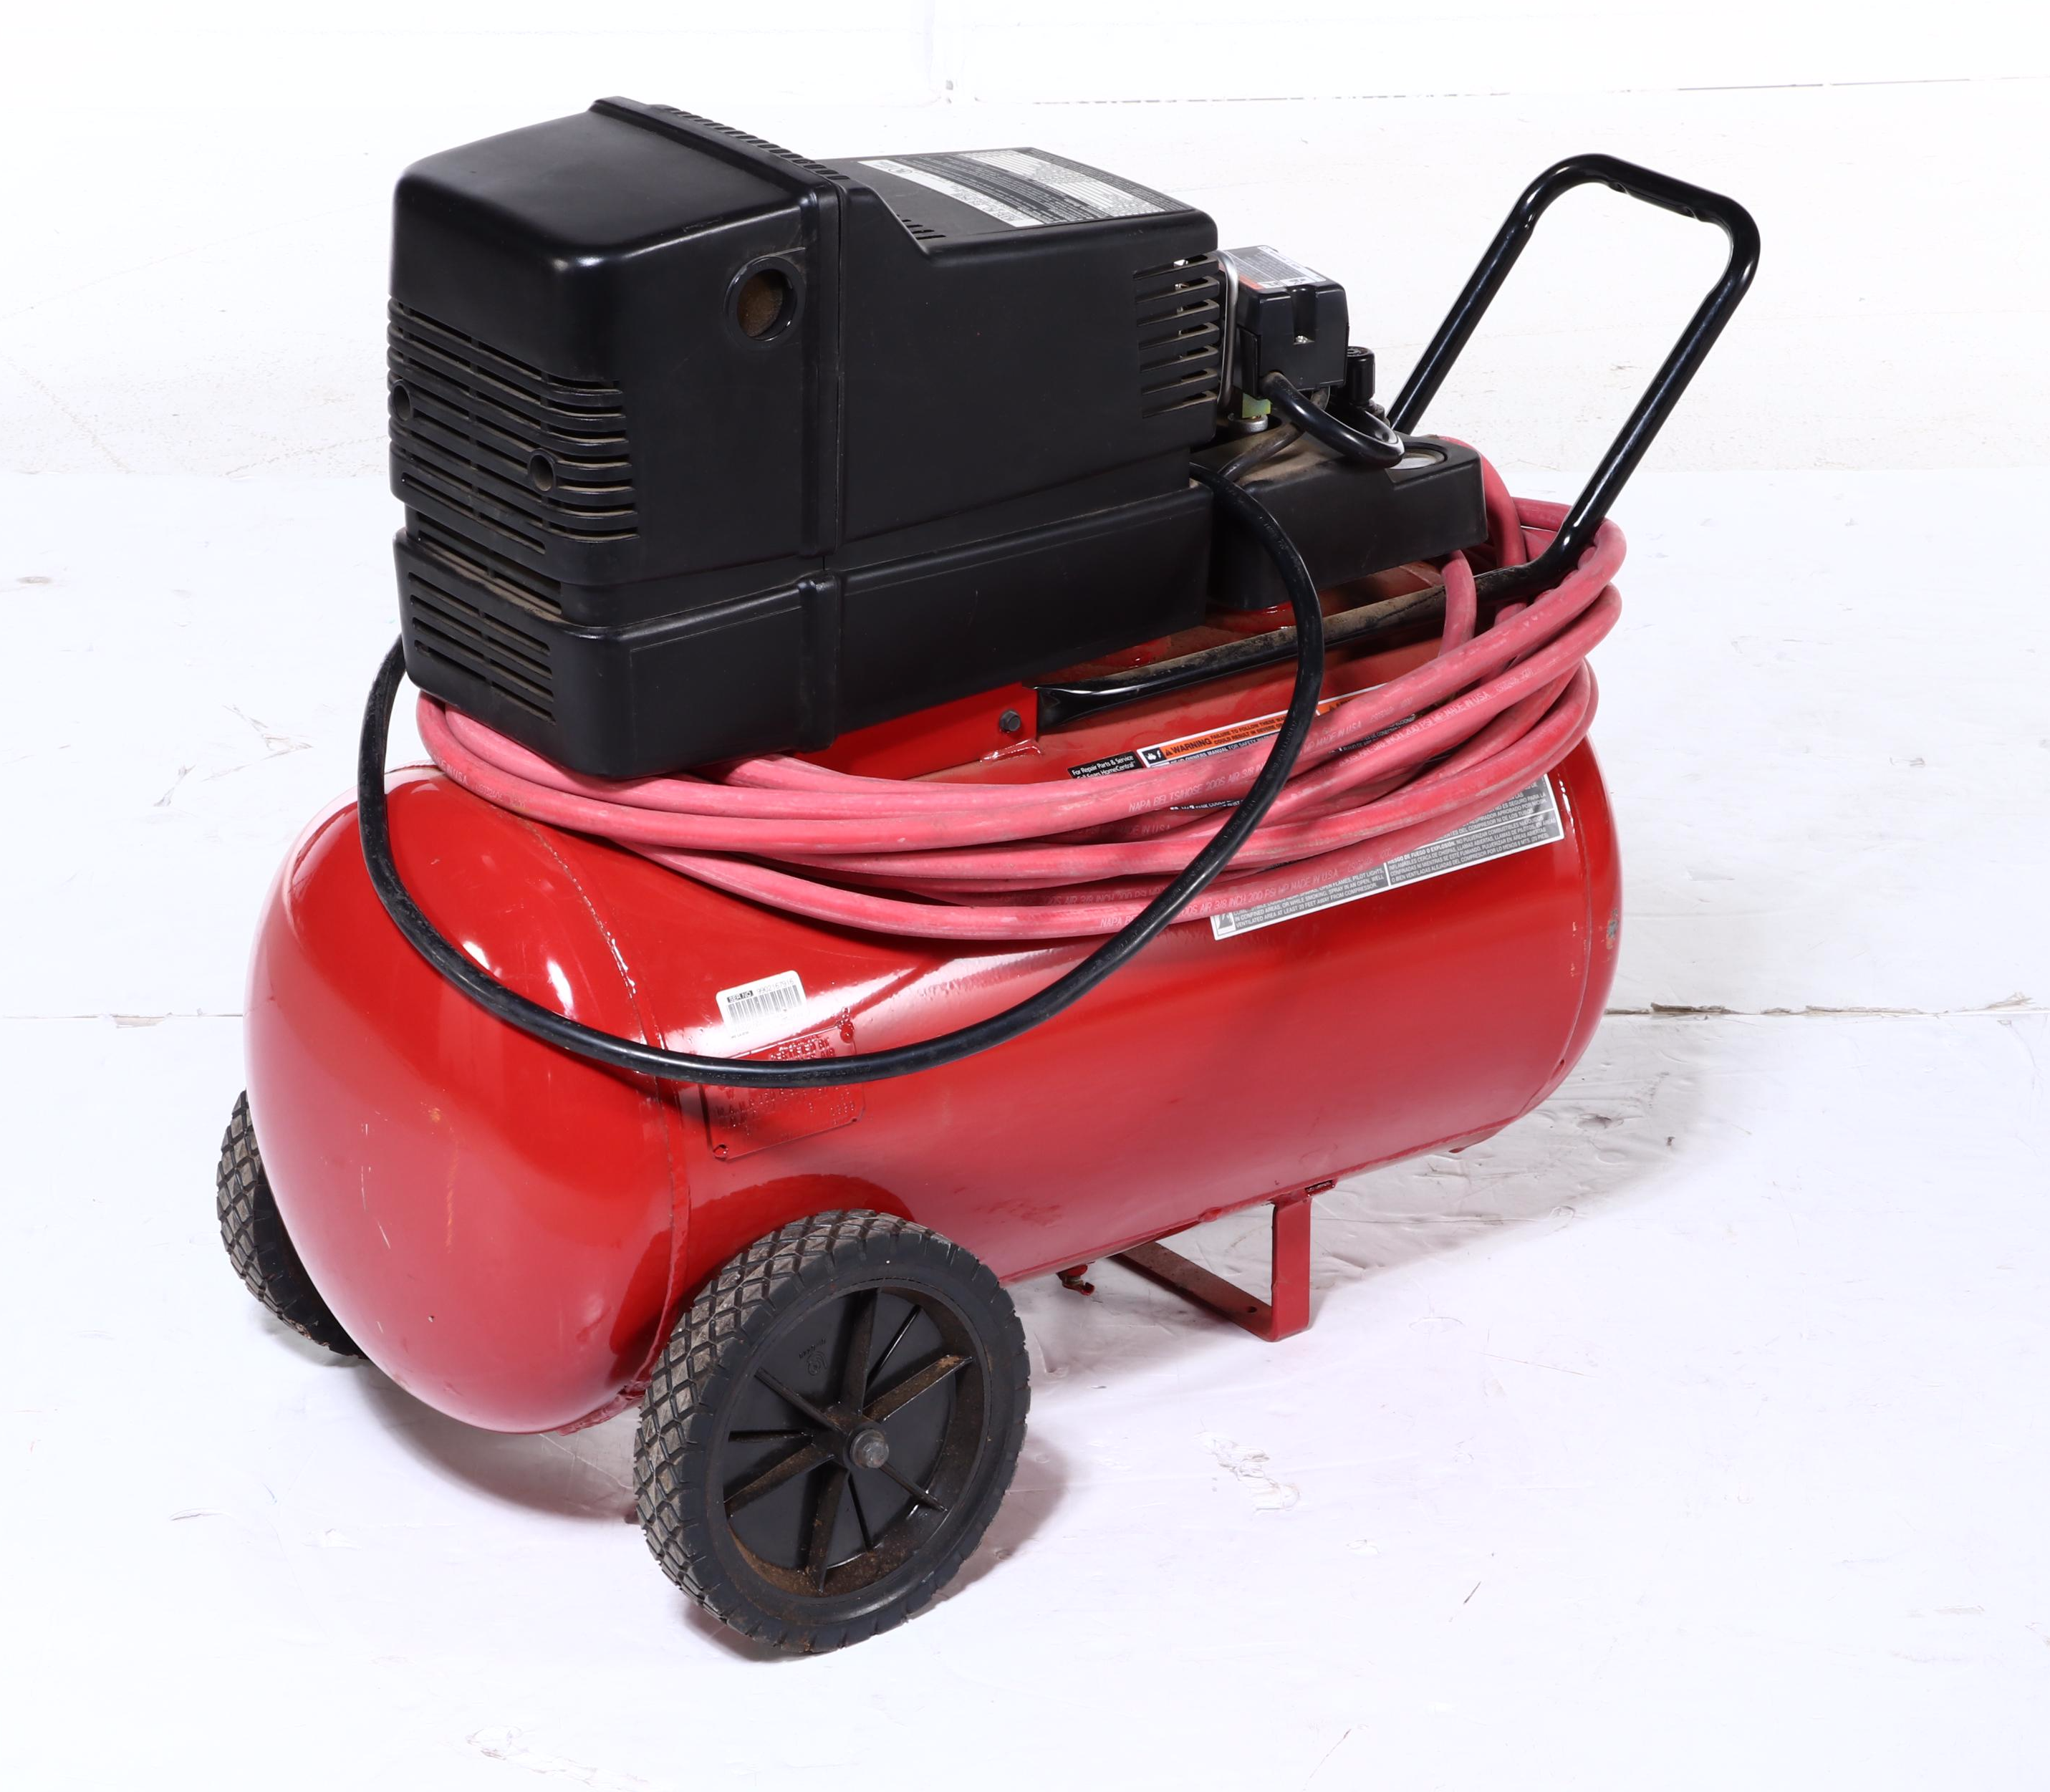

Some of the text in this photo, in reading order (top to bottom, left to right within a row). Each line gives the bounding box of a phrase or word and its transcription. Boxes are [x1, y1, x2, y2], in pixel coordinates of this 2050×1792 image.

[1472, 691, 1491, 707] USA
[1238, 722, 1259, 732] FOLLOW
[1170, 735, 1212, 754] WARNING
[1071, 768, 1081, 776] For
[1079, 763, 1098, 775] Repair
[1096, 760, 1111, 769] Parts
[1115, 753, 1134, 765] Service
[1129, 799, 1151, 813] NAPA
[1228, 772, 1240, 784] AIR
[1508, 796, 1527, 807] SEGURO
[1526, 793, 1539, 801] PARA
[1496, 804, 1522, 816] APROBADO
[1467, 818, 1497, 832] COMPRESOR
[1387, 857, 1417, 871] INFLAMABLES
[1416, 853, 1432, 862] CERCA
[1437, 845, 1457, 857] CHISPAS,
[1456, 841, 1474, 851] LLAMAS
[1473, 834, 1494, 846] ABIERTAS,
[1493, 829, 1511, 840] LLAMAS
[1410, 848, 1426, 858] FUEGO
[1462, 830, 1488, 843] PULVERIZAR
[1487, 821, 1519, 835] COMBUSTIBLES
[1389, 864, 1417, 877] CONFINADAS
[1420, 856, 1443, 867] MIENTRAS
[1481, 837, 1506, 849] PULVERIZAR
[1526, 826, 1546, 837] ABIERTAS
[1395, 873, 1405, 882] BIEN
[1405, 865, 1431, 878] VENTILADAS
[1430, 859, 1453, 871] ALEJADAS
[1459, 849, 1487, 862] COMPRESOR
[1501, 840, 1517, 850] MENOS
[1332, 877, 1352, 887] FLAMES,
[1352, 872, 1366, 881] PILOT
[1365, 867, 1384, 877] LIGHTS,
[1199, 902, 1213, 915] AIR
[1228, 894, 1247, 909] INCH
[1322, 869, 1339, 882] USA
[1239, 908, 1265, 920] CONFINED
[1264, 903, 1281, 913] AREAS,
[1289, 896, 1305, 906] WHILE
[1327, 885, 1344, 895] SPRAY
[1355, 877, 1372, 886] OPEN,
[1370, 873, 1385, 882] WELL
[1235, 915, 1264, 928] VENTILATED
[1263, 911, 1277, 920] AREA
[1282, 905, 1299, 914] LEAST
[1304, 899, 1317, 907] FEET
[1316, 895, 1330, 905] AWAY
[1329, 891, 1344, 900] FROM
[1343, 881, 1377, 896] COMPRESSOR.
[1100, 916, 1122, 928] NAPA
